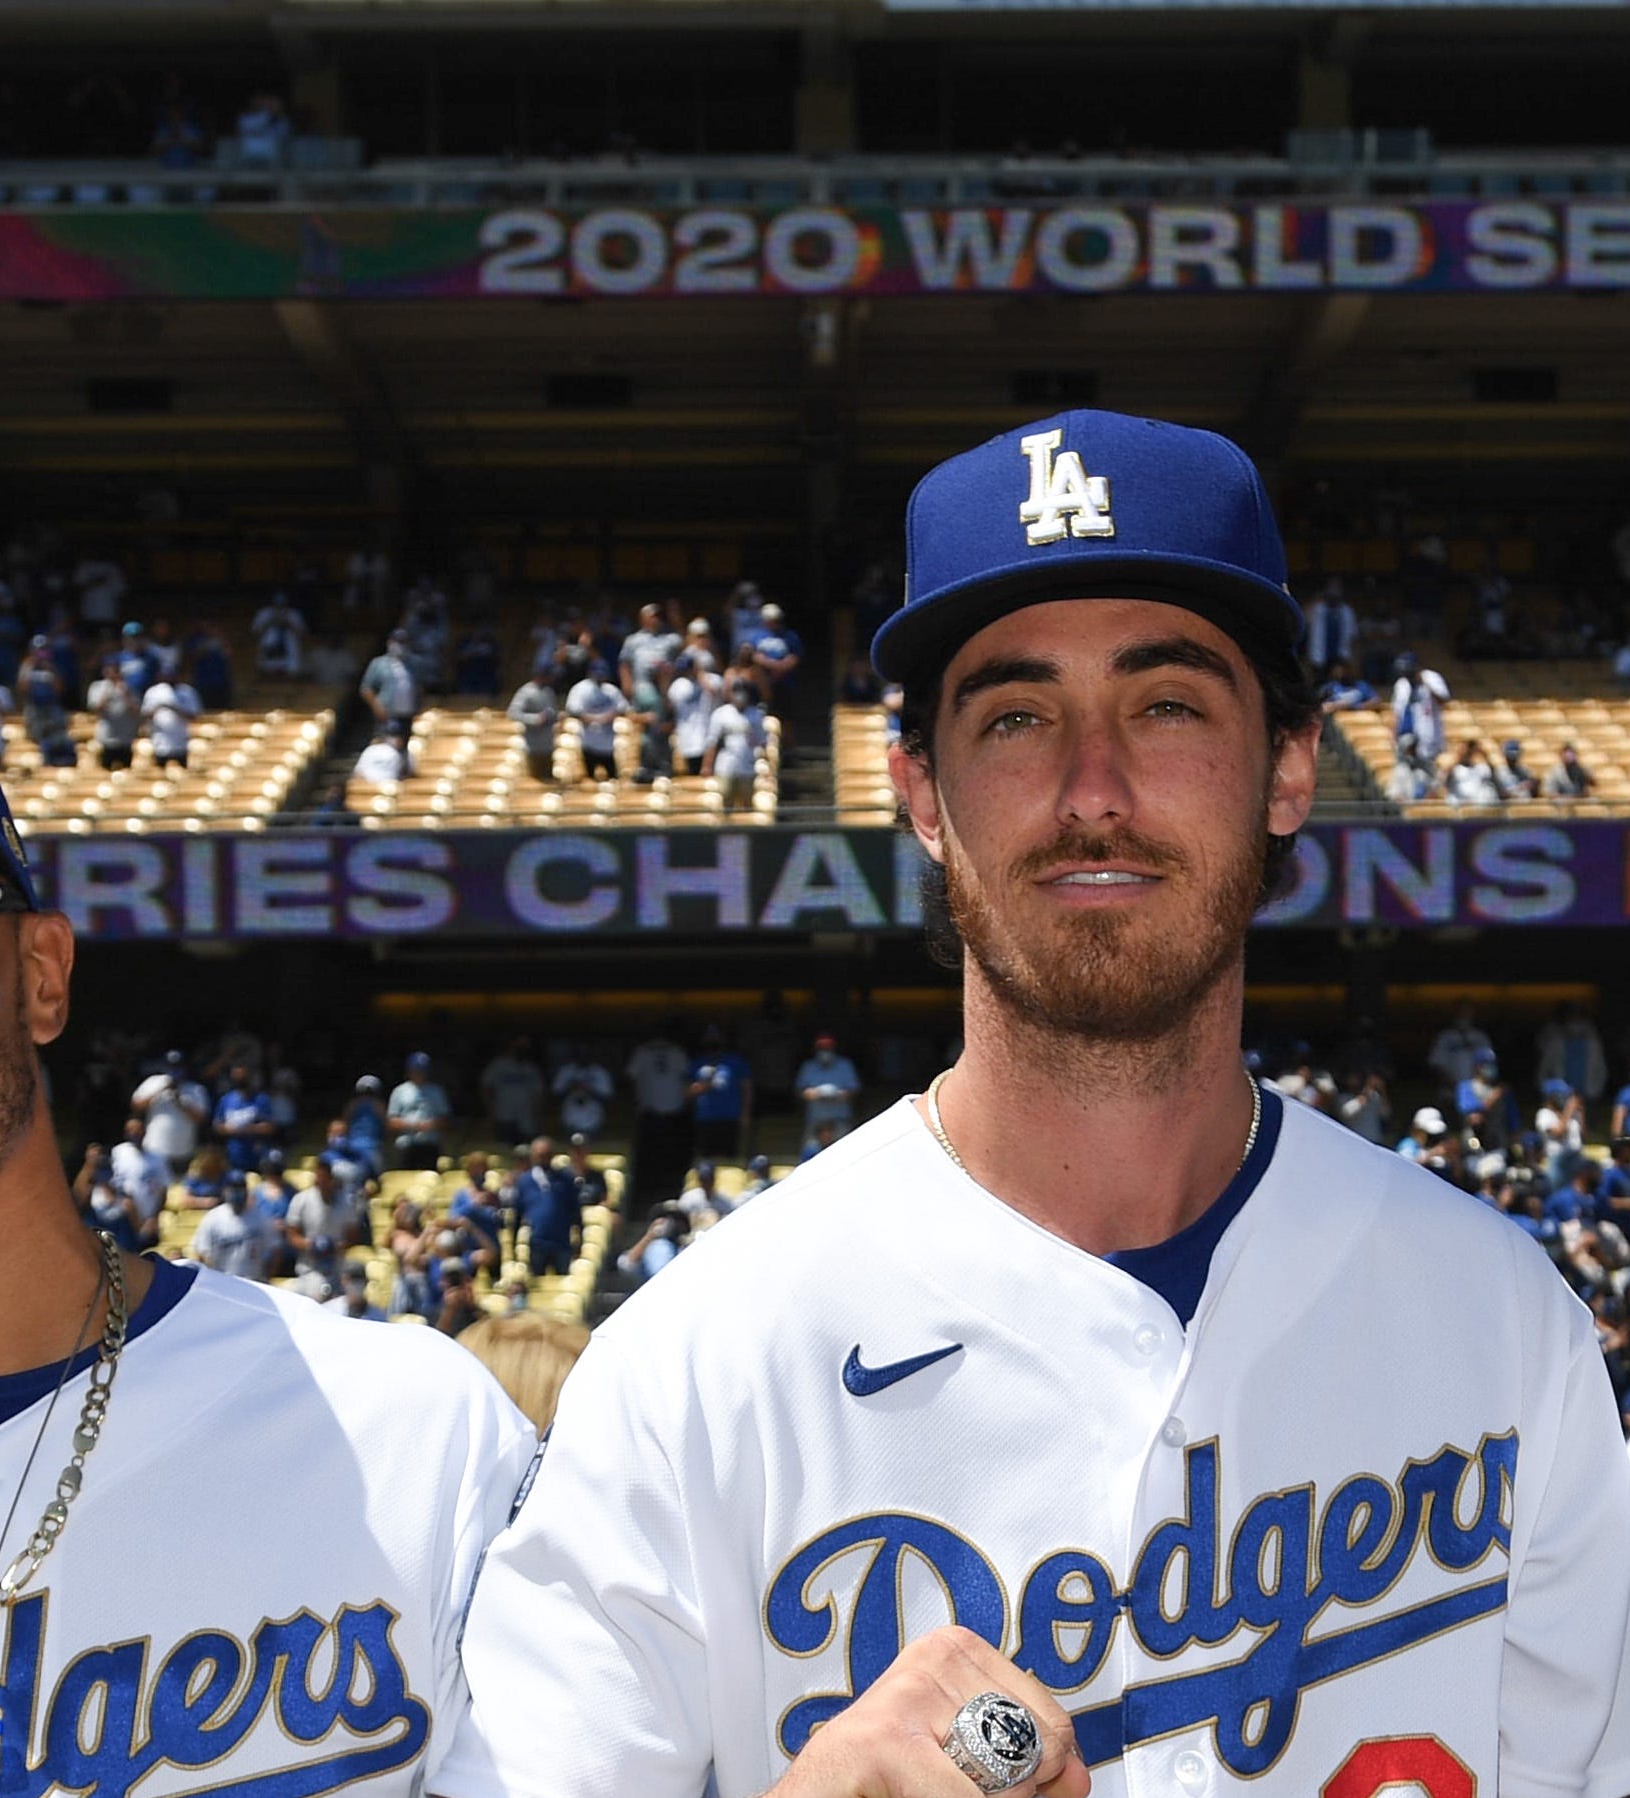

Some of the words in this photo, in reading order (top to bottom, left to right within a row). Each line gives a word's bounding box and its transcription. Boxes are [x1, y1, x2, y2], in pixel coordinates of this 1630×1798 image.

[478, 208, 859, 295] 2020
[904, 205, 1421, 291] WORLD
[1019, 428, 1116, 546] LA
[24, 834, 459, 936] RIES
